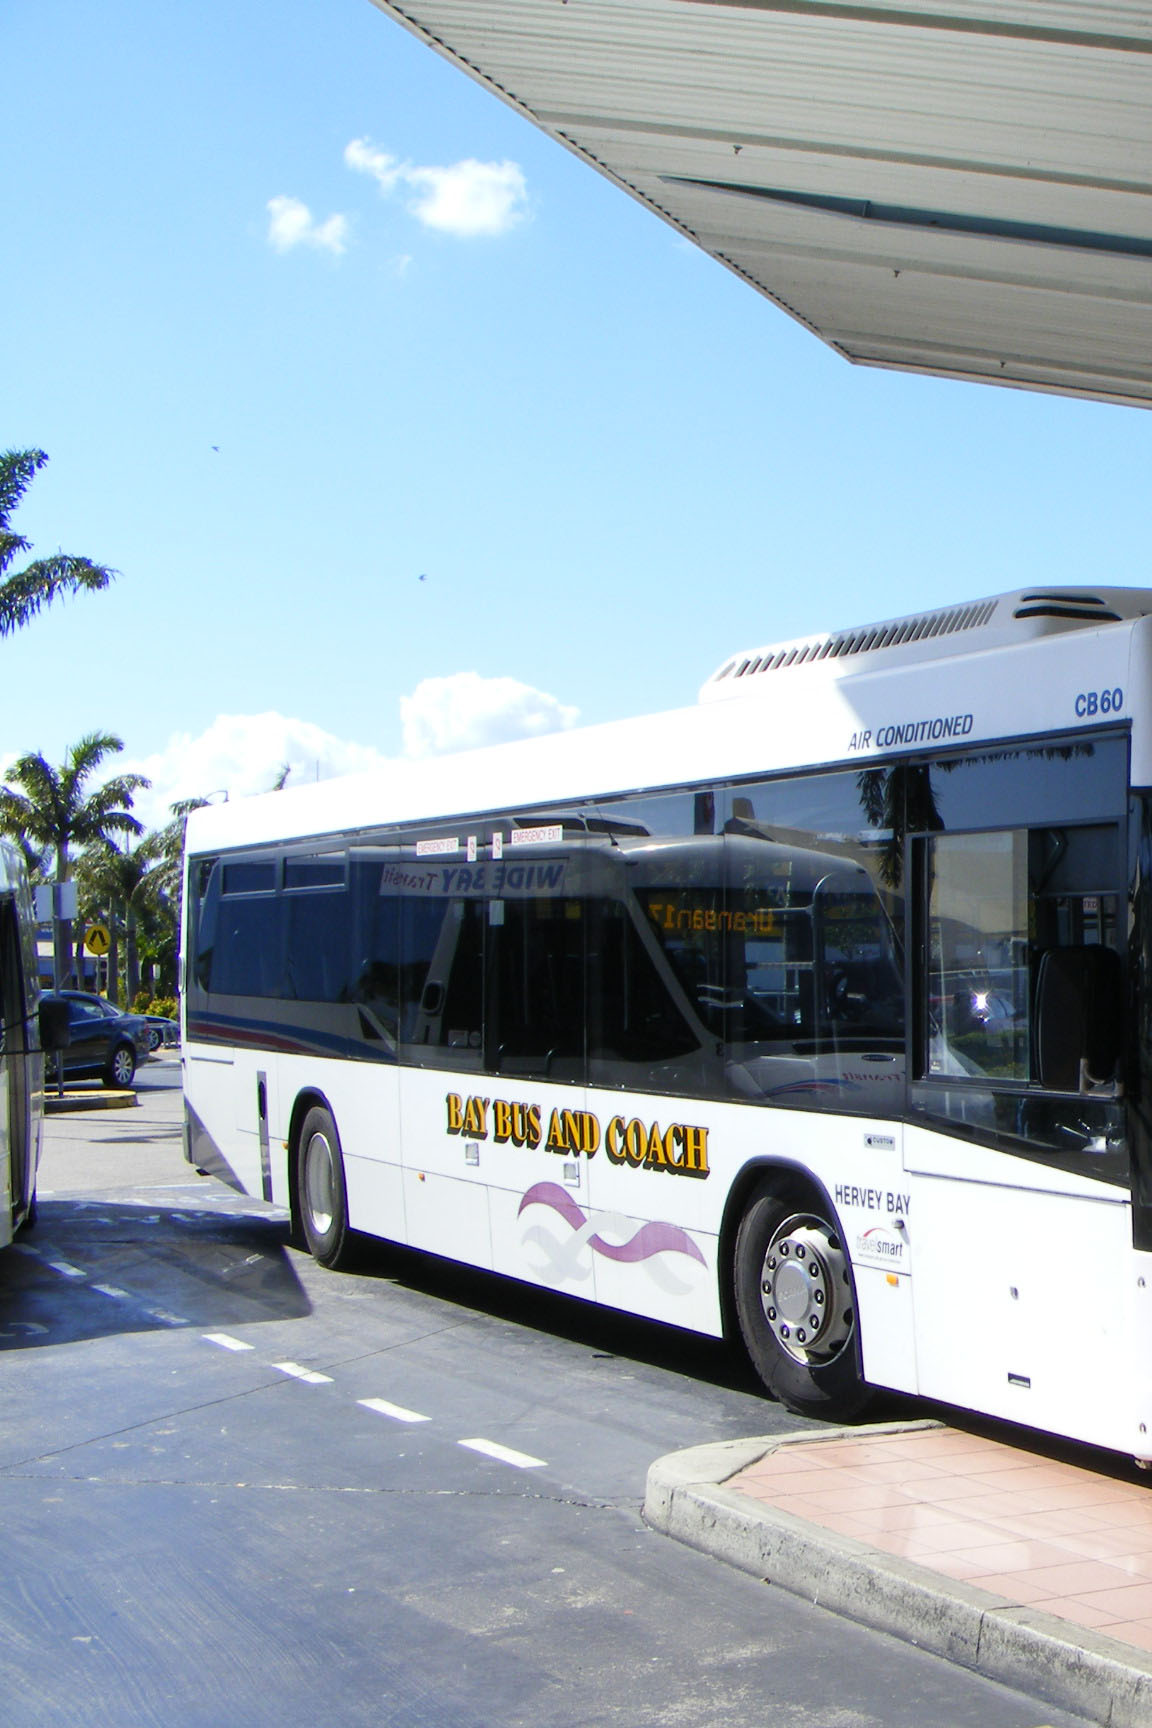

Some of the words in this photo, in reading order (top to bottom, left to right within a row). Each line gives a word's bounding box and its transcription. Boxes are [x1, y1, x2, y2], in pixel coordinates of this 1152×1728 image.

[1074, 687, 1123, 718] CB60
[848, 730, 872, 752] AIR
[876, 713, 974, 748] CONDITIONED
[513, 829, 546, 843] EMERGENCY
[548, 827, 561, 840] EXIT
[447, 1092, 490, 1141] BAY
[493, 1099, 542, 1150] BUS
[545, 1107, 601, 1160] AND
[605, 1115, 711, 1179] COACH
[835, 1183, 883, 1211] HERVEY
[886, 1191, 911, 1215] BAY
